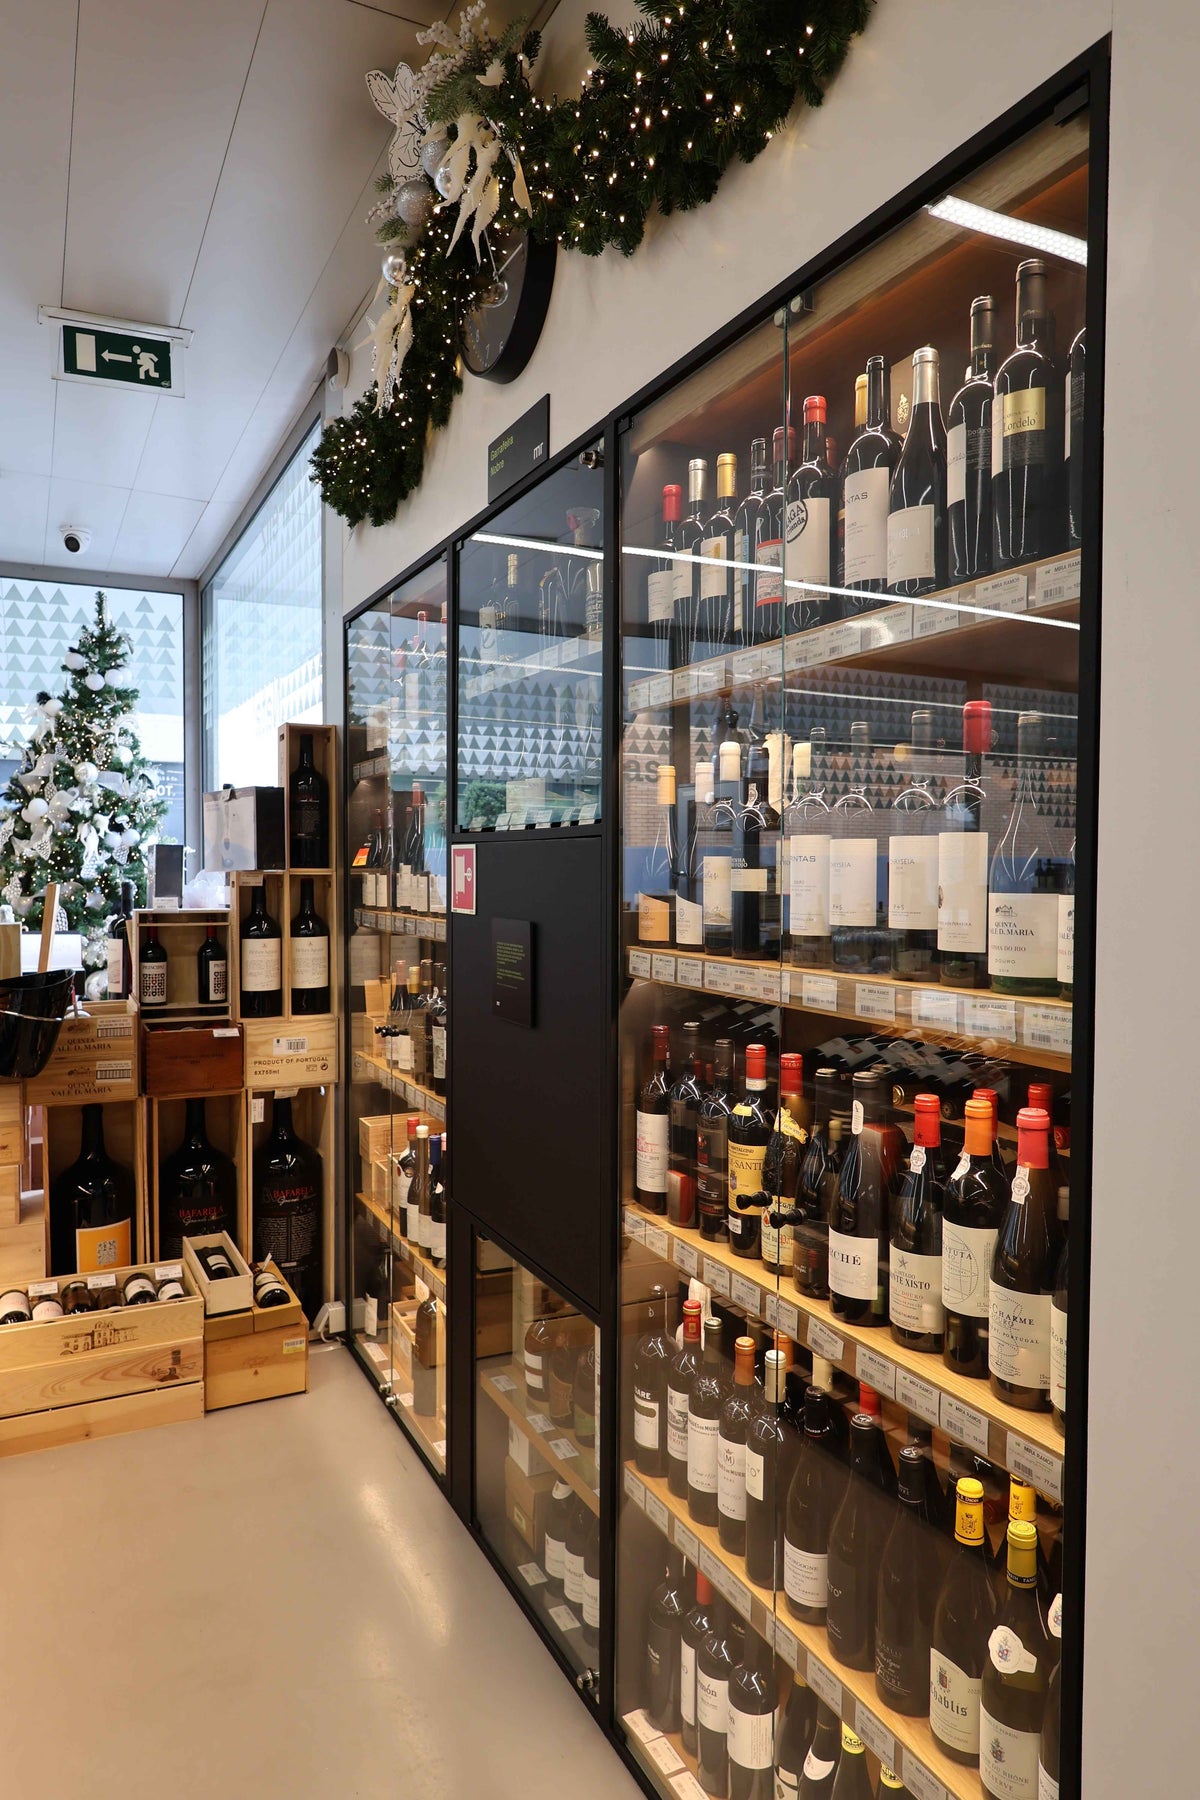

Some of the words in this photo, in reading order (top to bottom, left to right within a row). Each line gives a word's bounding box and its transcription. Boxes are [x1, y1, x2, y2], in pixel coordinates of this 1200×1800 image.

[1006, 928, 1034, 936] MARIA
[84, 1086, 112, 1094] MARIA
[905, 1278, 931, 1290] XISTO
[991, 1303, 1035, 1326] CHARME
[1002, 1332, 1040, 1345] PORTUGAL
[1024, 1445, 1036, 1456] MIRA
